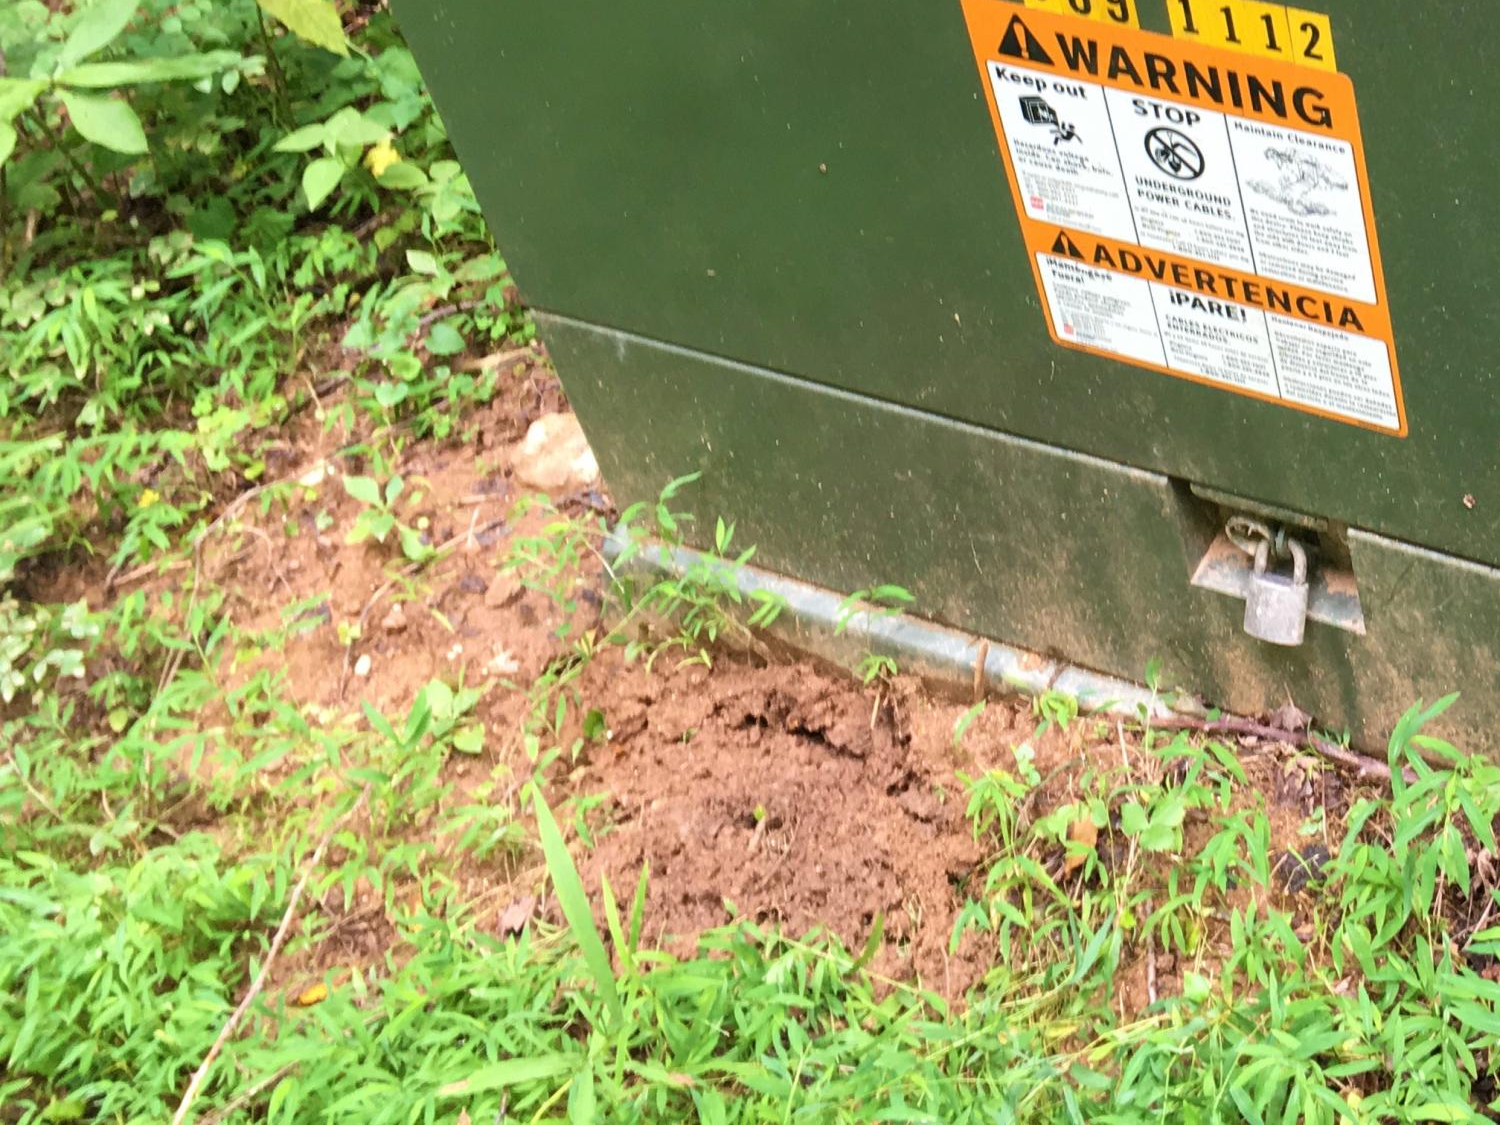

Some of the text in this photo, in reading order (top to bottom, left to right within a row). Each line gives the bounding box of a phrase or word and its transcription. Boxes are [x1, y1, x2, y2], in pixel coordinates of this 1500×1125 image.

[995, 65, 1088, 100] Keep out
[1055, 31, 1333, 129] WARNING
[1132, 99, 1200, 127] STOP
[1135, 175, 1231, 206] UNDERGROUND
[1137, 188, 1180, 206] POWER
[1094, 243, 1364, 332] ADVERTENCIA
